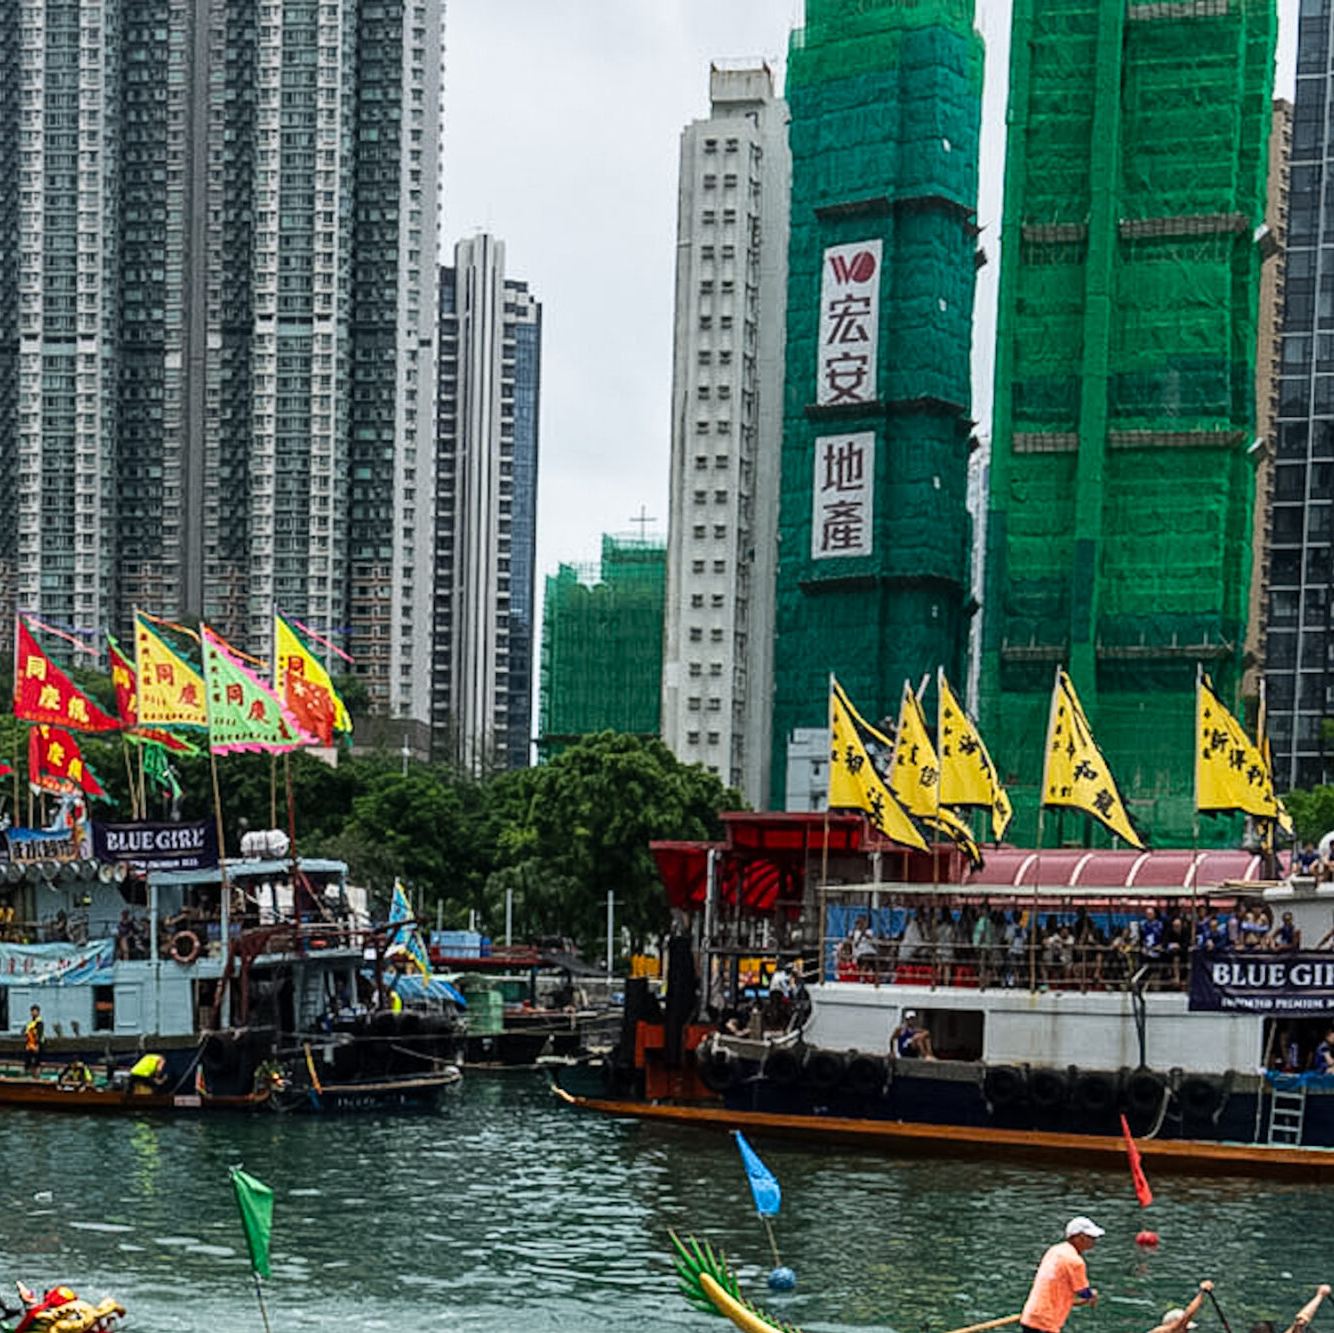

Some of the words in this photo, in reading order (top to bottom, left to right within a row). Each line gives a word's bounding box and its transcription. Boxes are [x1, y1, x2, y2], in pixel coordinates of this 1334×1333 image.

[824, 293, 872, 405] 宏安
[819, 442, 865, 552] 地產
[105, 830, 154, 852] BLUE
[155, 828, 204, 850] GIRL
[1212, 962, 1286, 986] BLUE
